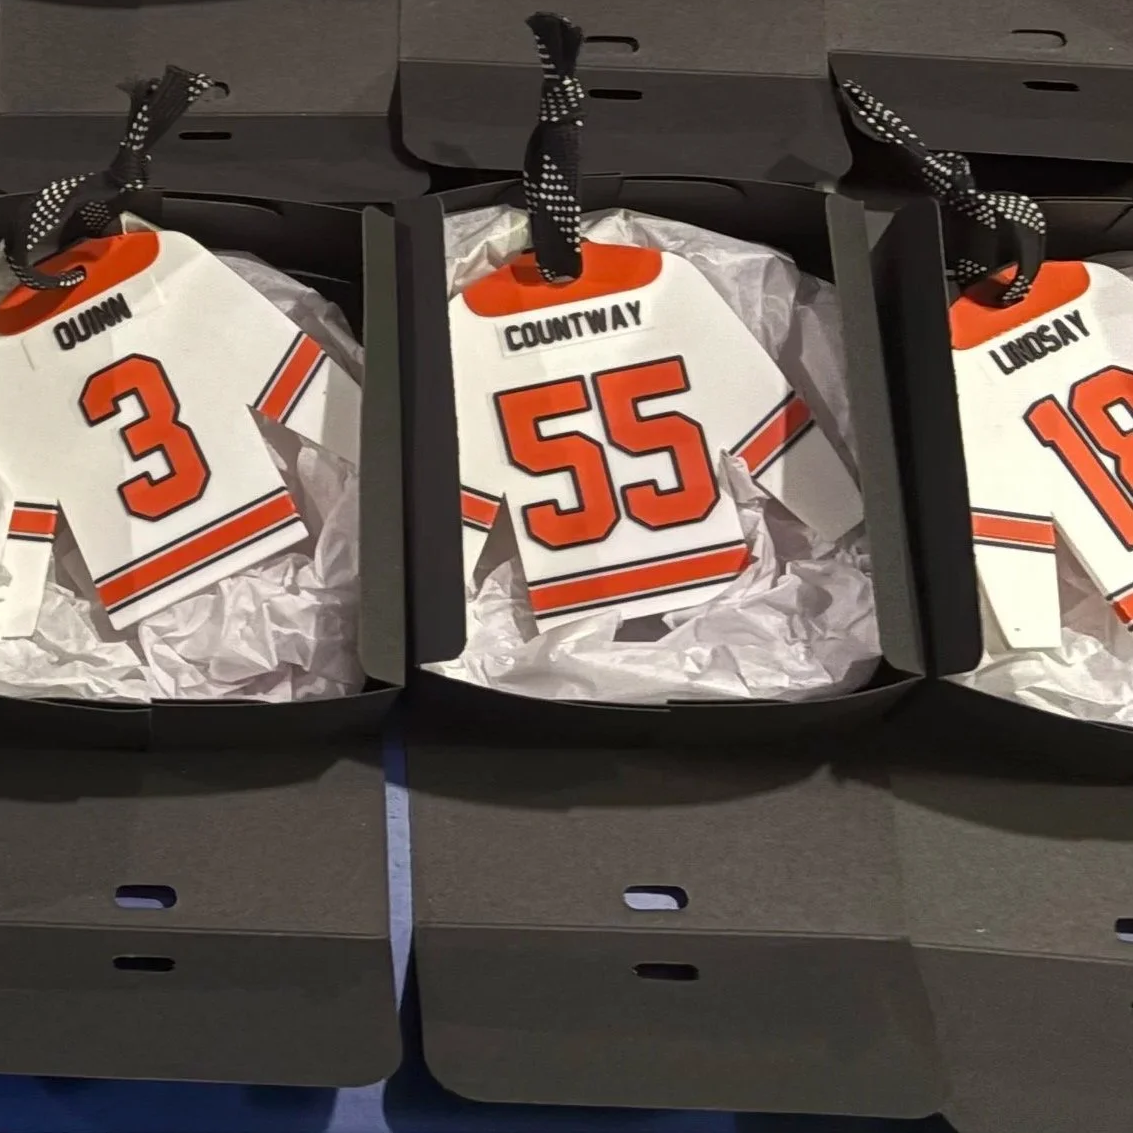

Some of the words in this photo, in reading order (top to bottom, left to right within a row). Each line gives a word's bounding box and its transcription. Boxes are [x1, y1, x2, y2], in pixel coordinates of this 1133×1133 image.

[53, 292, 132, 352] QUINN
[503, 300, 643, 353] COUNTWAY
[988, 310, 1092, 377] LINDSAY
[77, 353, 212, 522] 3
[493, 355, 721, 552] 55
